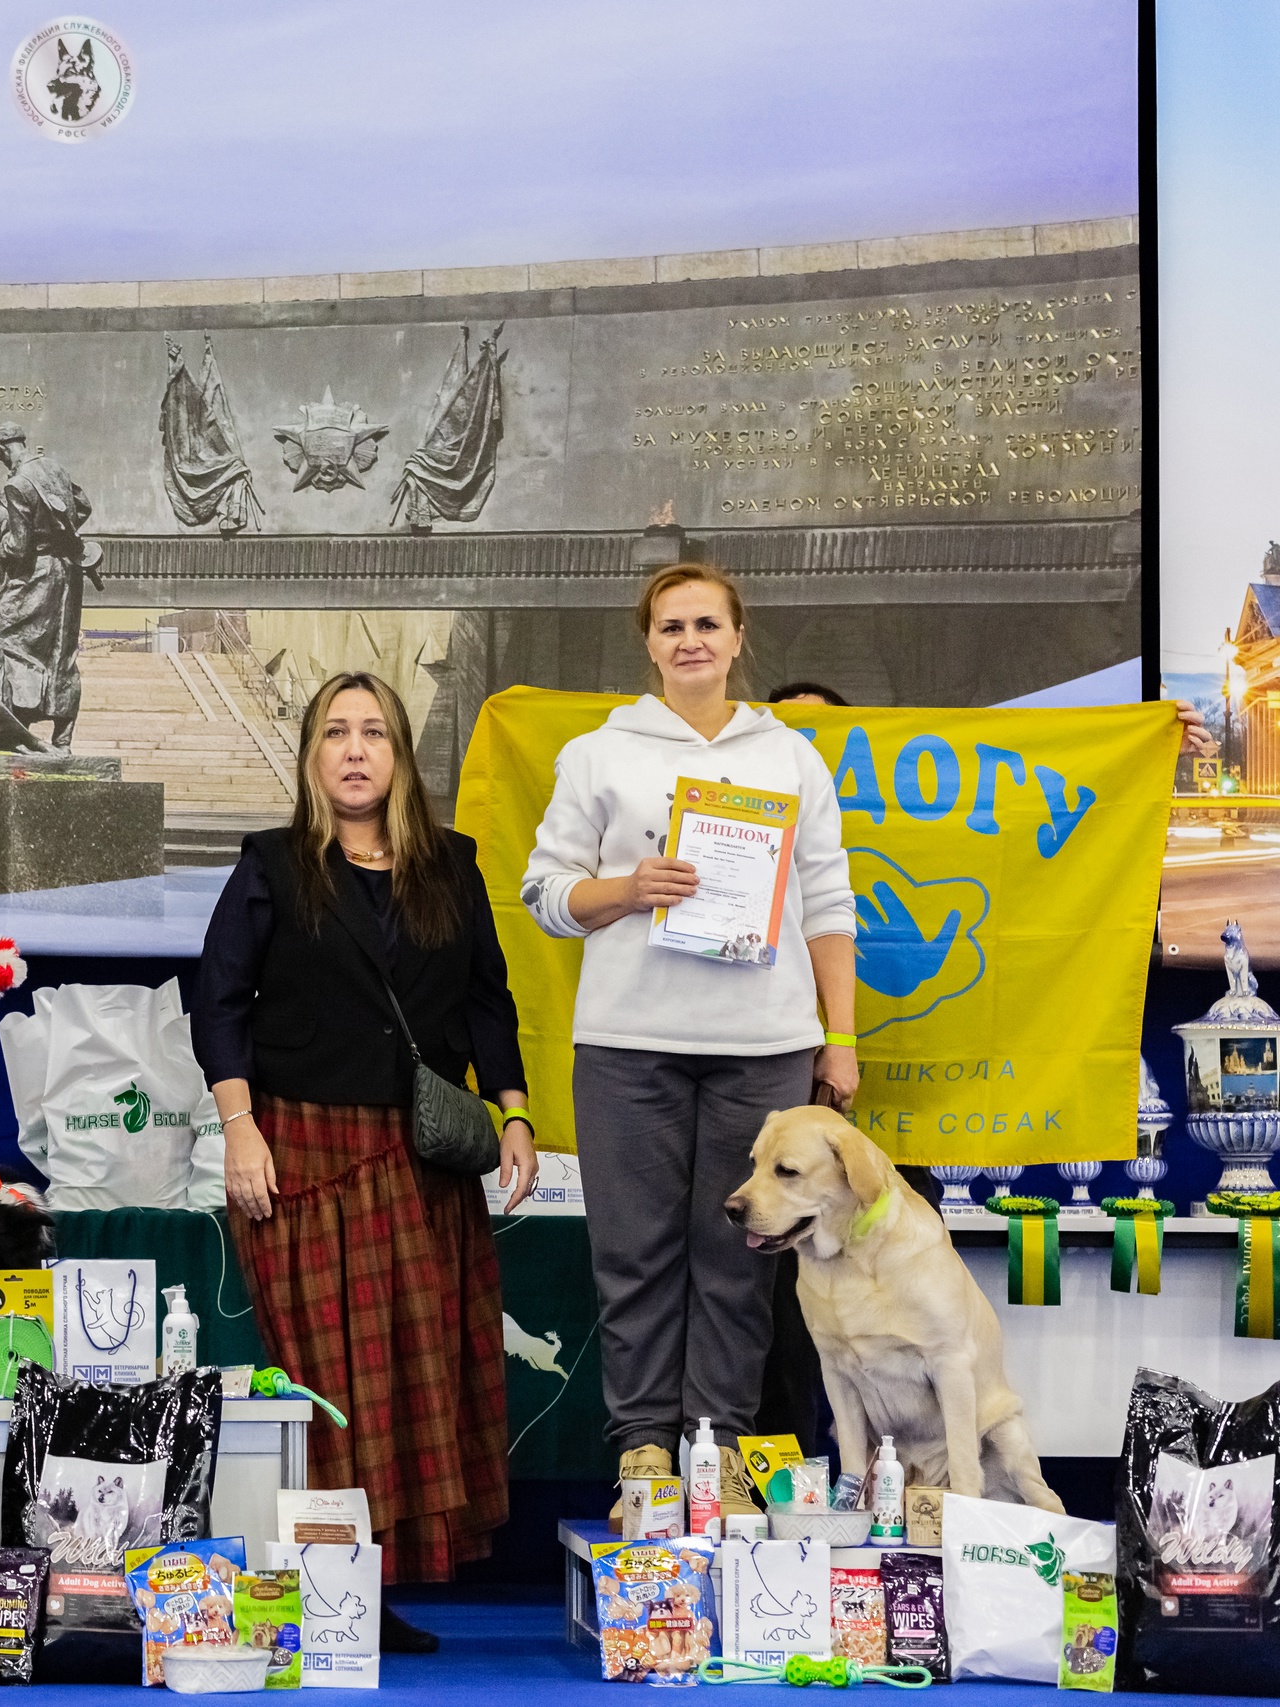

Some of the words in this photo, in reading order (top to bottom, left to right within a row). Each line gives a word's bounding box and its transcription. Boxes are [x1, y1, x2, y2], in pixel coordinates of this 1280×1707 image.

[17, 22, 63, 69] ФЕДЕРАЦИЯ
[62, 21, 123, 55] СЛУЖЕБНОГО
[15, 68, 45, 128] РОССИЙСКАЯ
[97, 51, 132, 130] СОБАКОВОДСТВА
[57, 127, 88, 139] РФСС
[670, 428, 799, 446] МУЖЕСТВО
[869, 462, 1001, 482] ЛЕНИНГРАД
[705, 790, 789, 814] ЗООШОУ
[793, 726, 1097, 860] ДОГУ
[692, 820, 771, 845] ДИПЛОМ
[885, 1059, 1016, 1083] ШКОЛА
[64, 1111, 121, 1133] HORSE
[938, 1108, 1063, 1135] СОБАК
[960, 1543, 1032, 1568] HORSE
[58, 1577, 81, 1586] Adult
[83, 1578, 100, 1588] Dog
[1171, 1577, 1193, 1587] Adult
[1195, 1577, 1211, 1588] Dog
[1211, 1577, 1239, 1587] Active
[892, 1613, 935, 1629] WIPES
